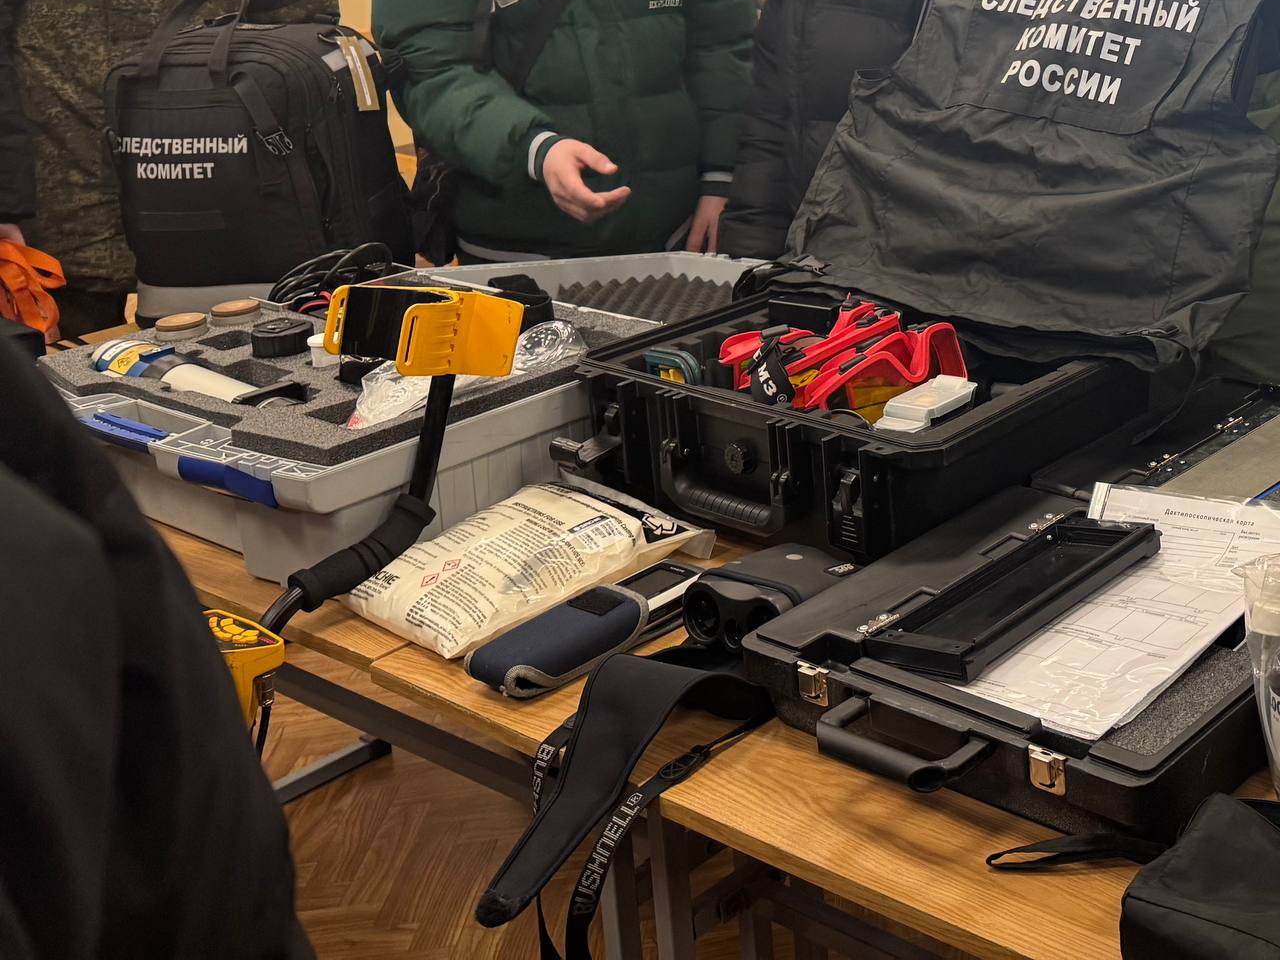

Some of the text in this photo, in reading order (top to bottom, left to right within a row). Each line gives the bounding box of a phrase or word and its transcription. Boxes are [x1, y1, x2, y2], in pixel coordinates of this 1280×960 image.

[1015, 22, 1142, 65] КОМИТЕТ
[1000, 58, 1122, 105] РОССИИ
[136, 162, 215, 180] КОМИТЕТ
[1164, 507, 1235, 525] Дактилоскопическая
[1236, 518, 1255, 527] карта
